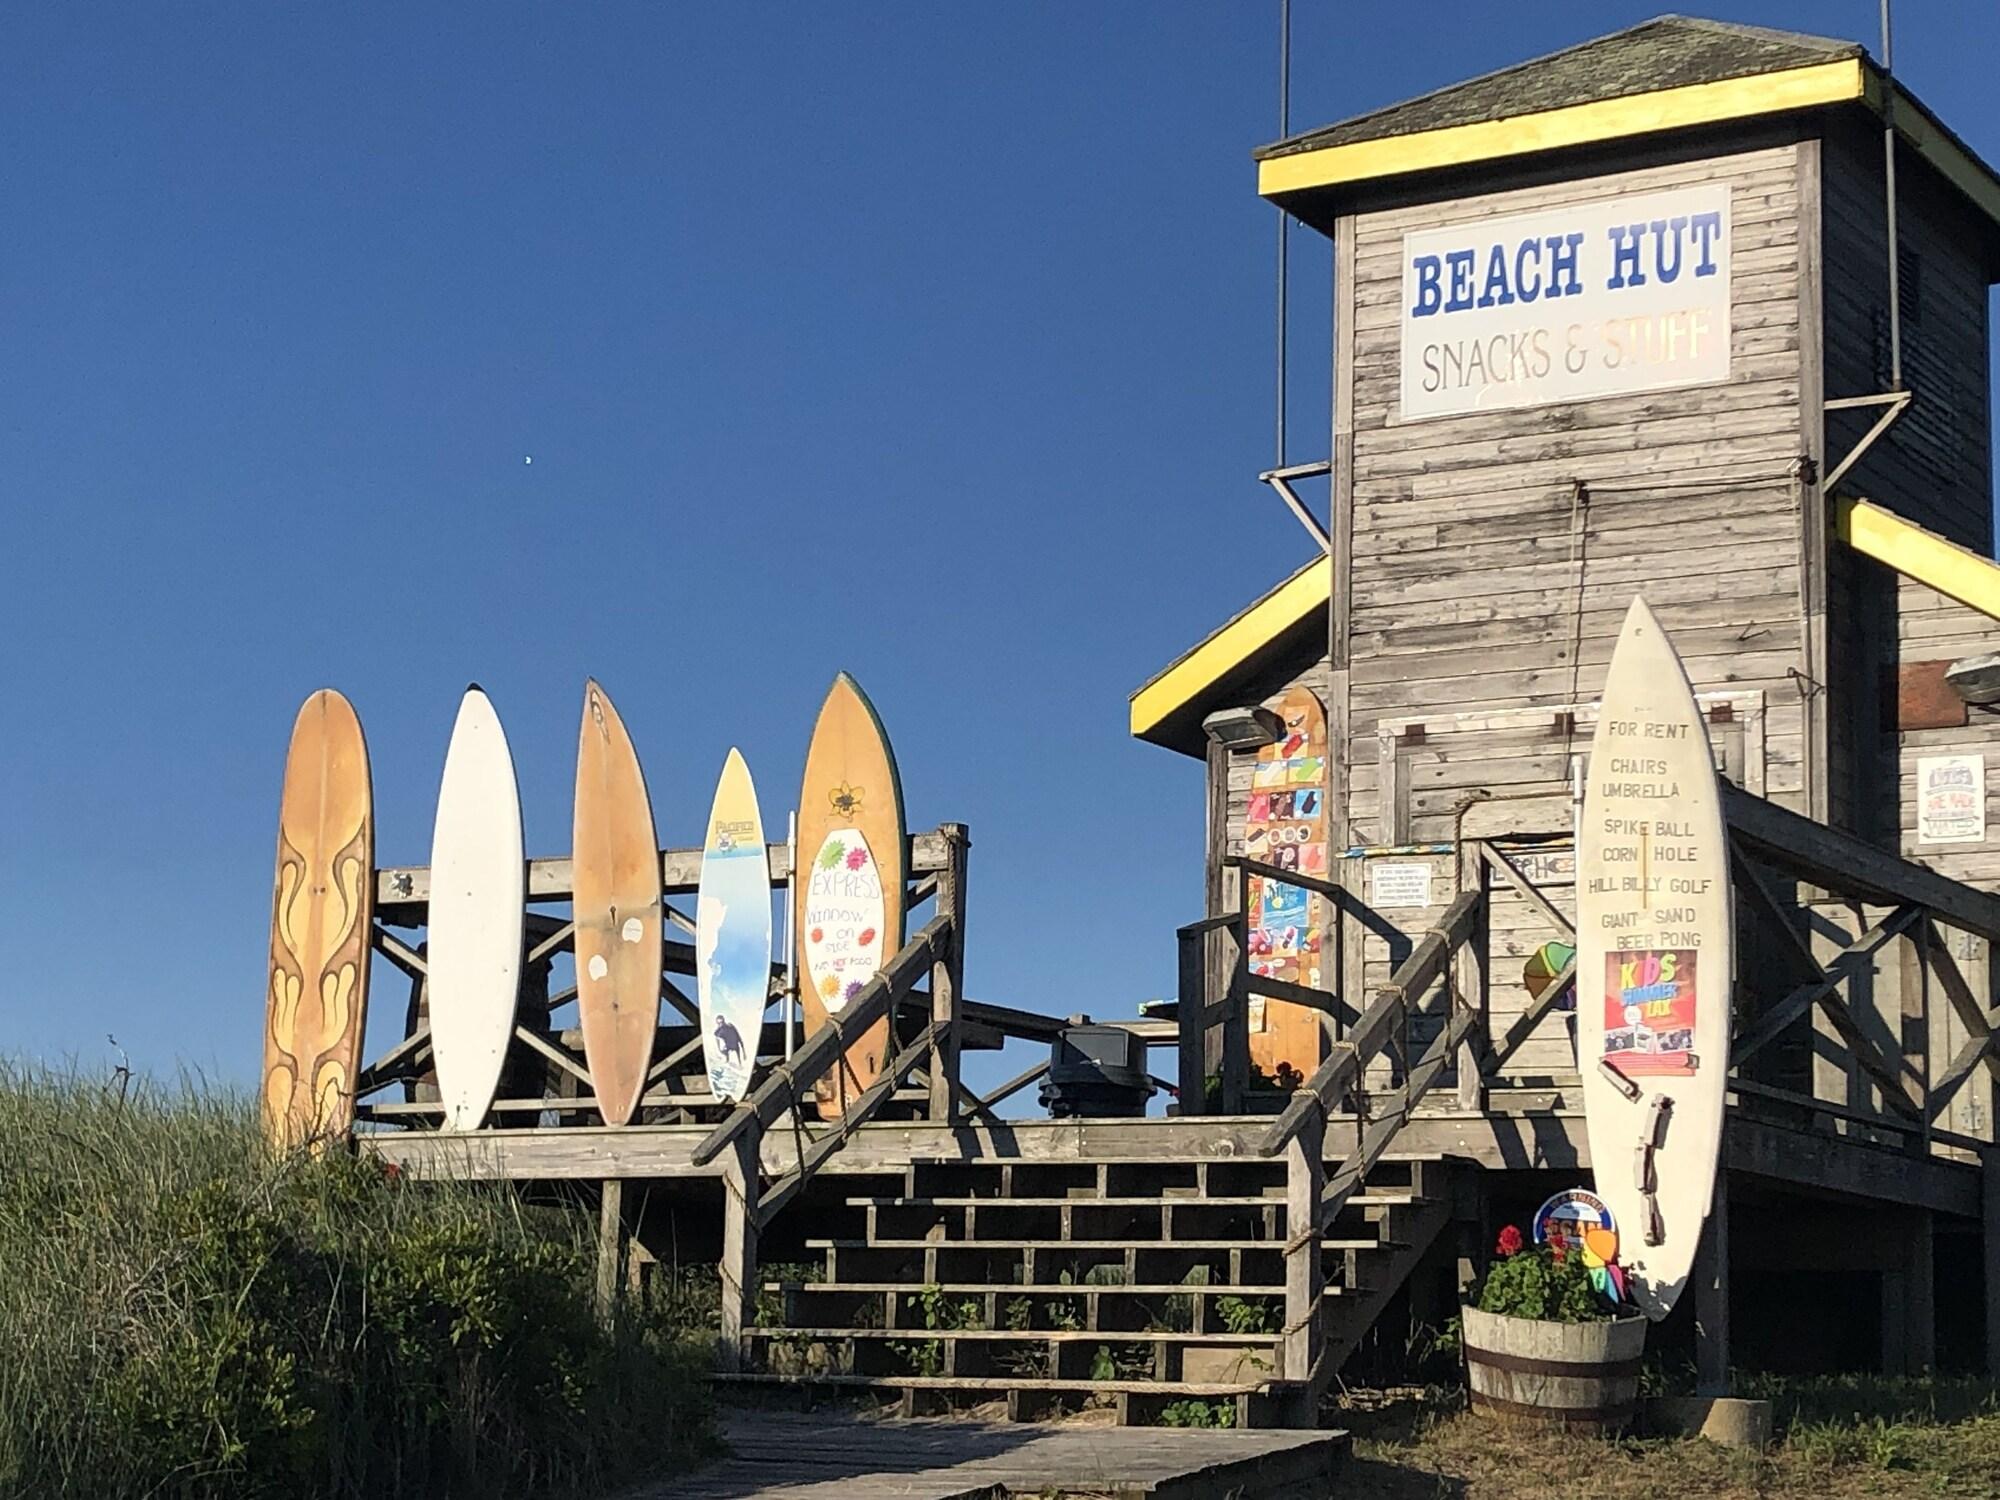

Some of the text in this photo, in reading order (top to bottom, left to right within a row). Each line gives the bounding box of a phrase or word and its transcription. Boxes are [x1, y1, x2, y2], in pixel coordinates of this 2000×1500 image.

[1411, 210, 1722, 319] BEACH HUT
[1421, 306, 1712, 394] SNACKS & STUFF
[1608, 720, 1690, 740] FOR RENT
[1610, 758, 1668, 776] CHAIRS
[1602, 782, 1681, 799] UMBRELLA
[1604, 818, 1696, 838] SPIKE BALL
[1602, 846, 1699, 863] CORN HOLE
[811, 871, 880, 900] EXPRESS
[1588, 876, 1713, 895] HILL BILLY GOLF
[1601, 907, 1697, 929] GIANT SAND
[1616, 931, 1702, 950] BEER PONG
